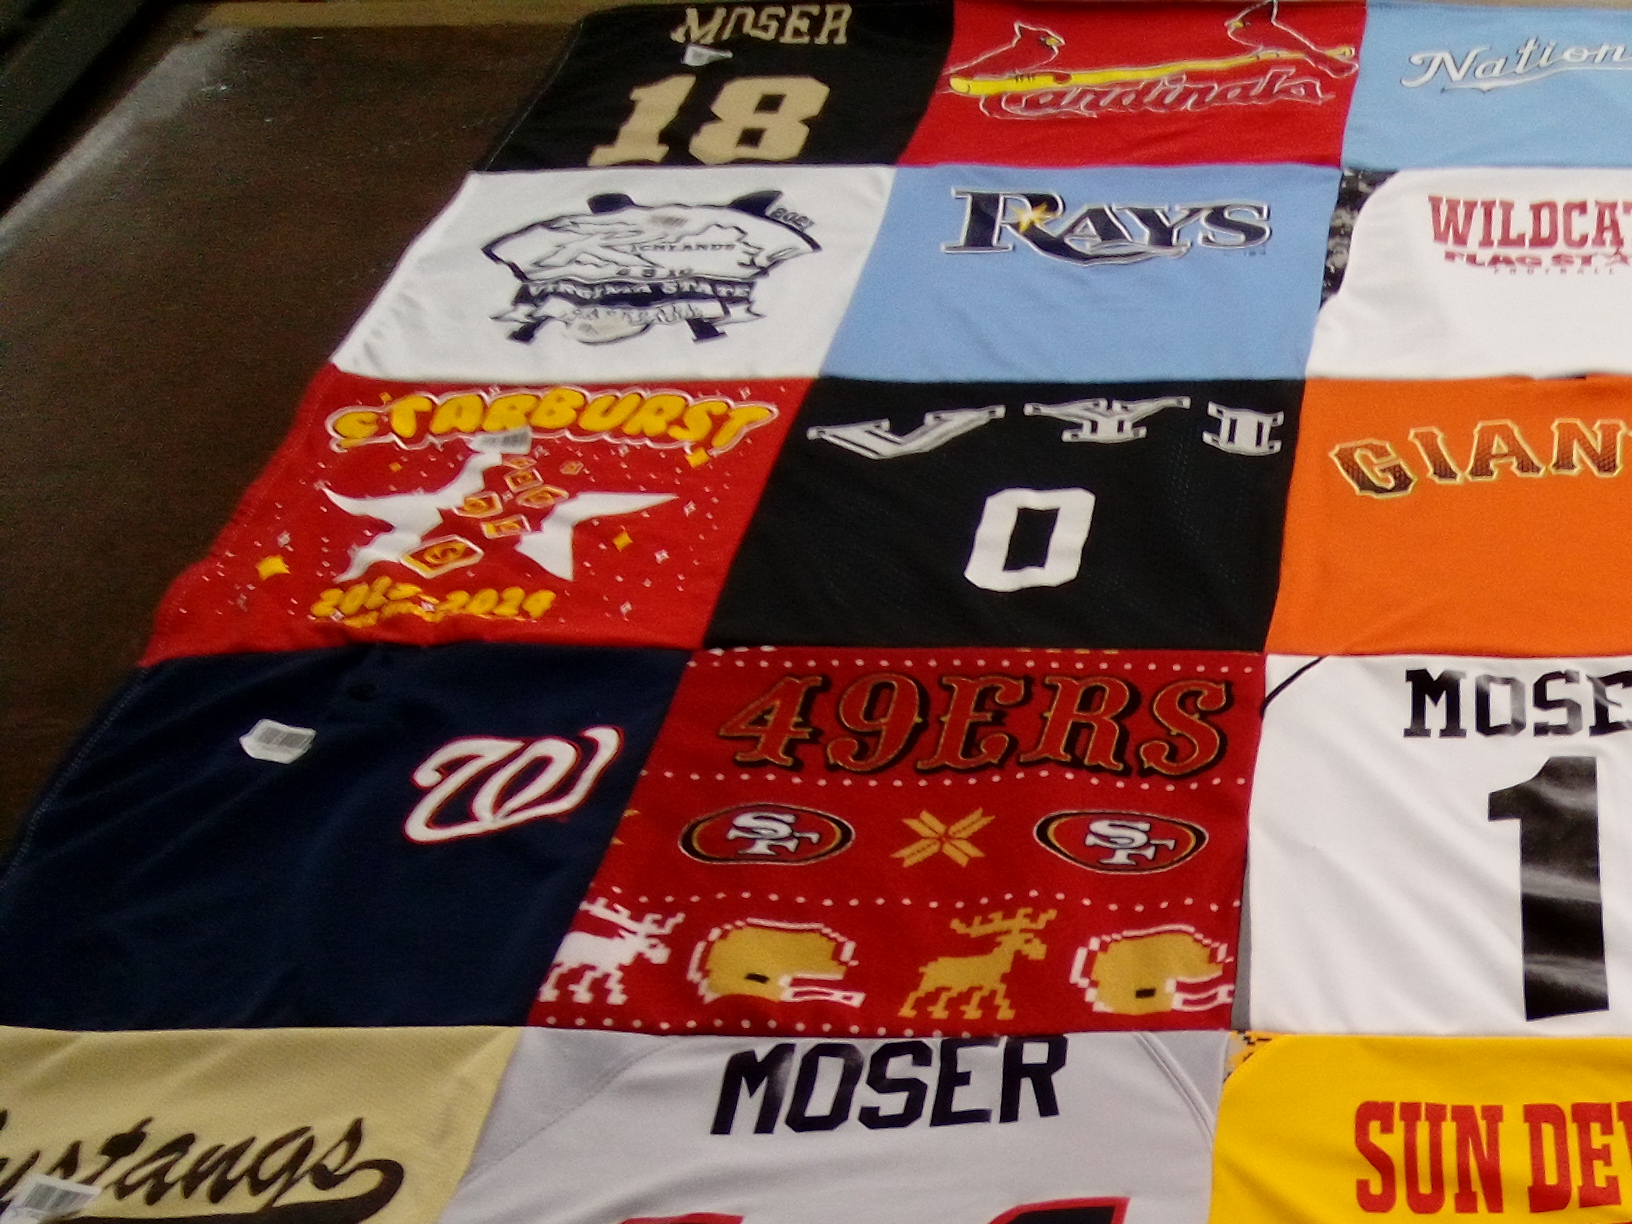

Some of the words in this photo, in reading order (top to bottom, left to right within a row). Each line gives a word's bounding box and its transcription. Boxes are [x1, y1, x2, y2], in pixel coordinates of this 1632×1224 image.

[670, 4, 852, 44] MOSER
[587, 74, 831, 167] 18
[941, 187, 1274, 267] RAYS
[326, 386, 779, 455] STARBURST
[717, 671, 1236, 776] 49ERS
[725, 810, 821, 855] SF
[1083, 818, 1178, 865] SF
[1488, 756, 1610, 1022] 1
[710, 1036, 1069, 1136] MOSER
[1354, 1100, 1505, 1215] SUN
